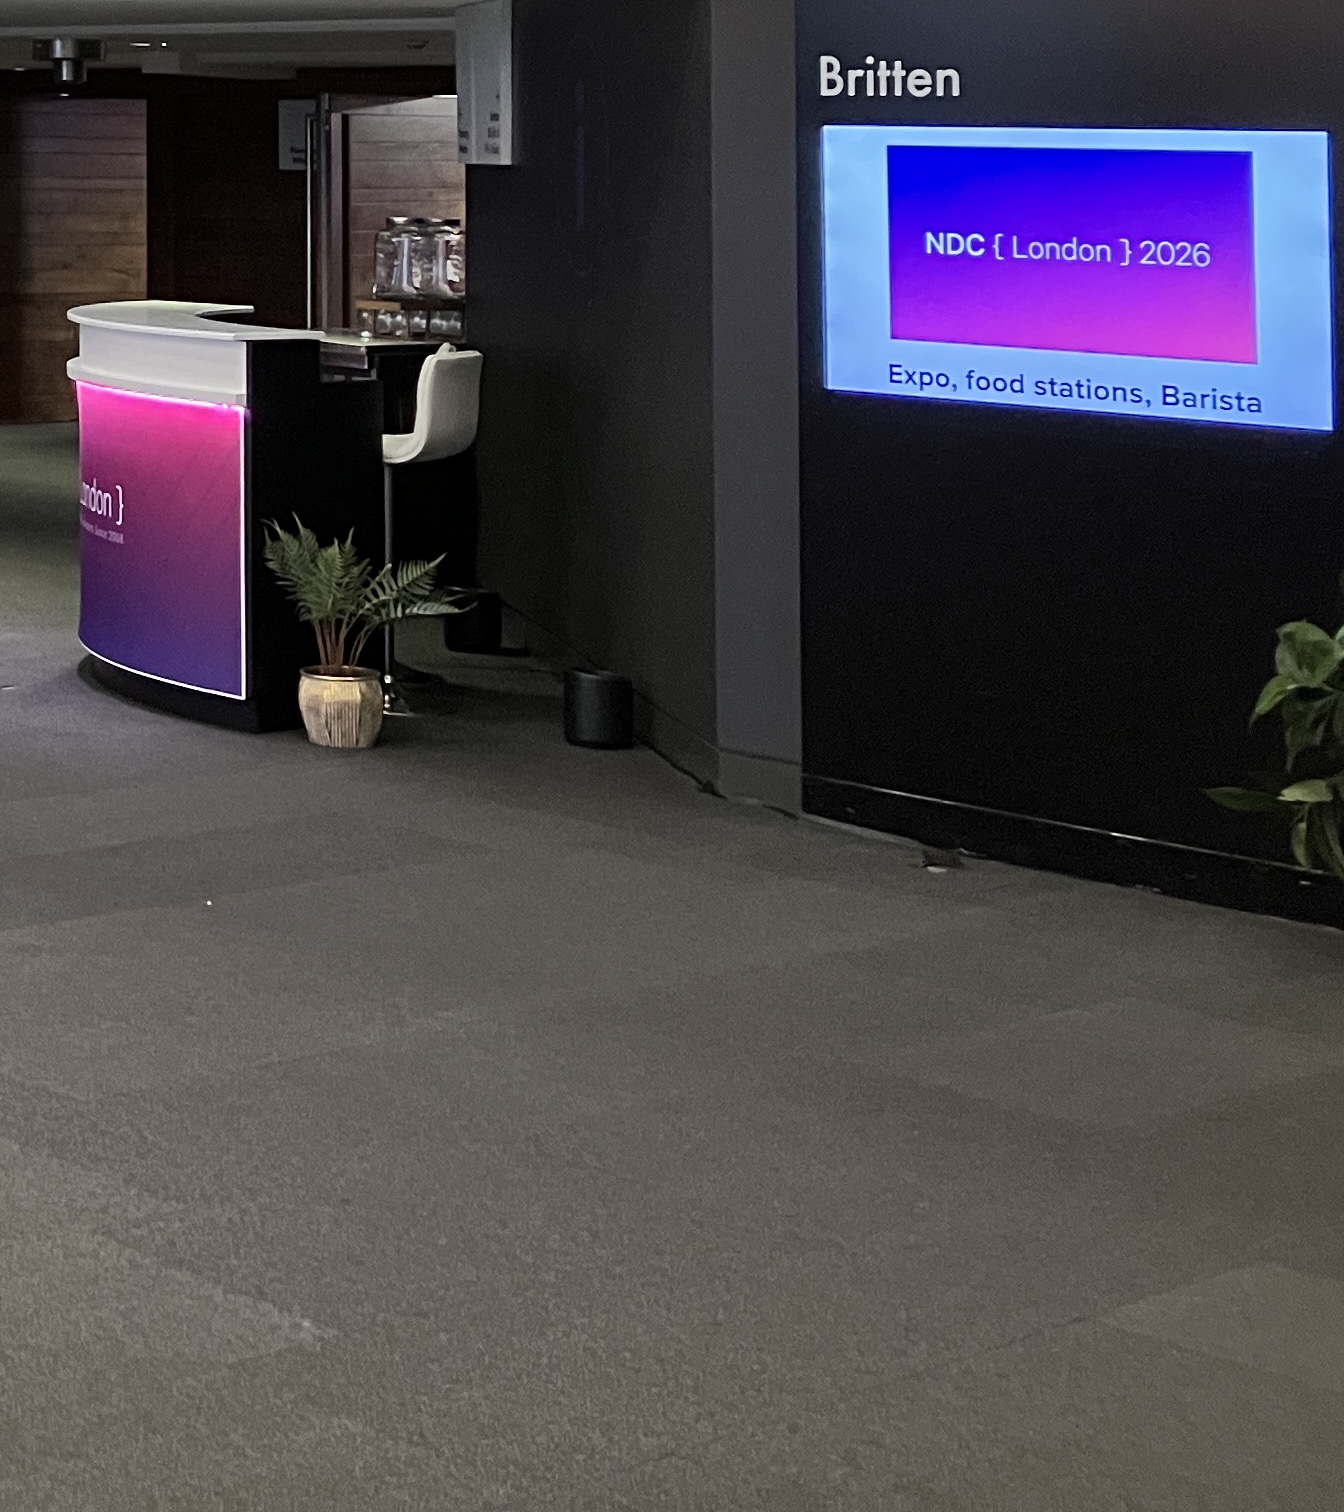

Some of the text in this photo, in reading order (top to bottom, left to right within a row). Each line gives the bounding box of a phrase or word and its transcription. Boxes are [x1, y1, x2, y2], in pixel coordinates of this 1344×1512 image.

[820, 56, 959, 97] Britten
[926, 232, 1210, 267] NDC { London } 2026
[888, 364, 1263, 414] Expo, food stations, Barista
